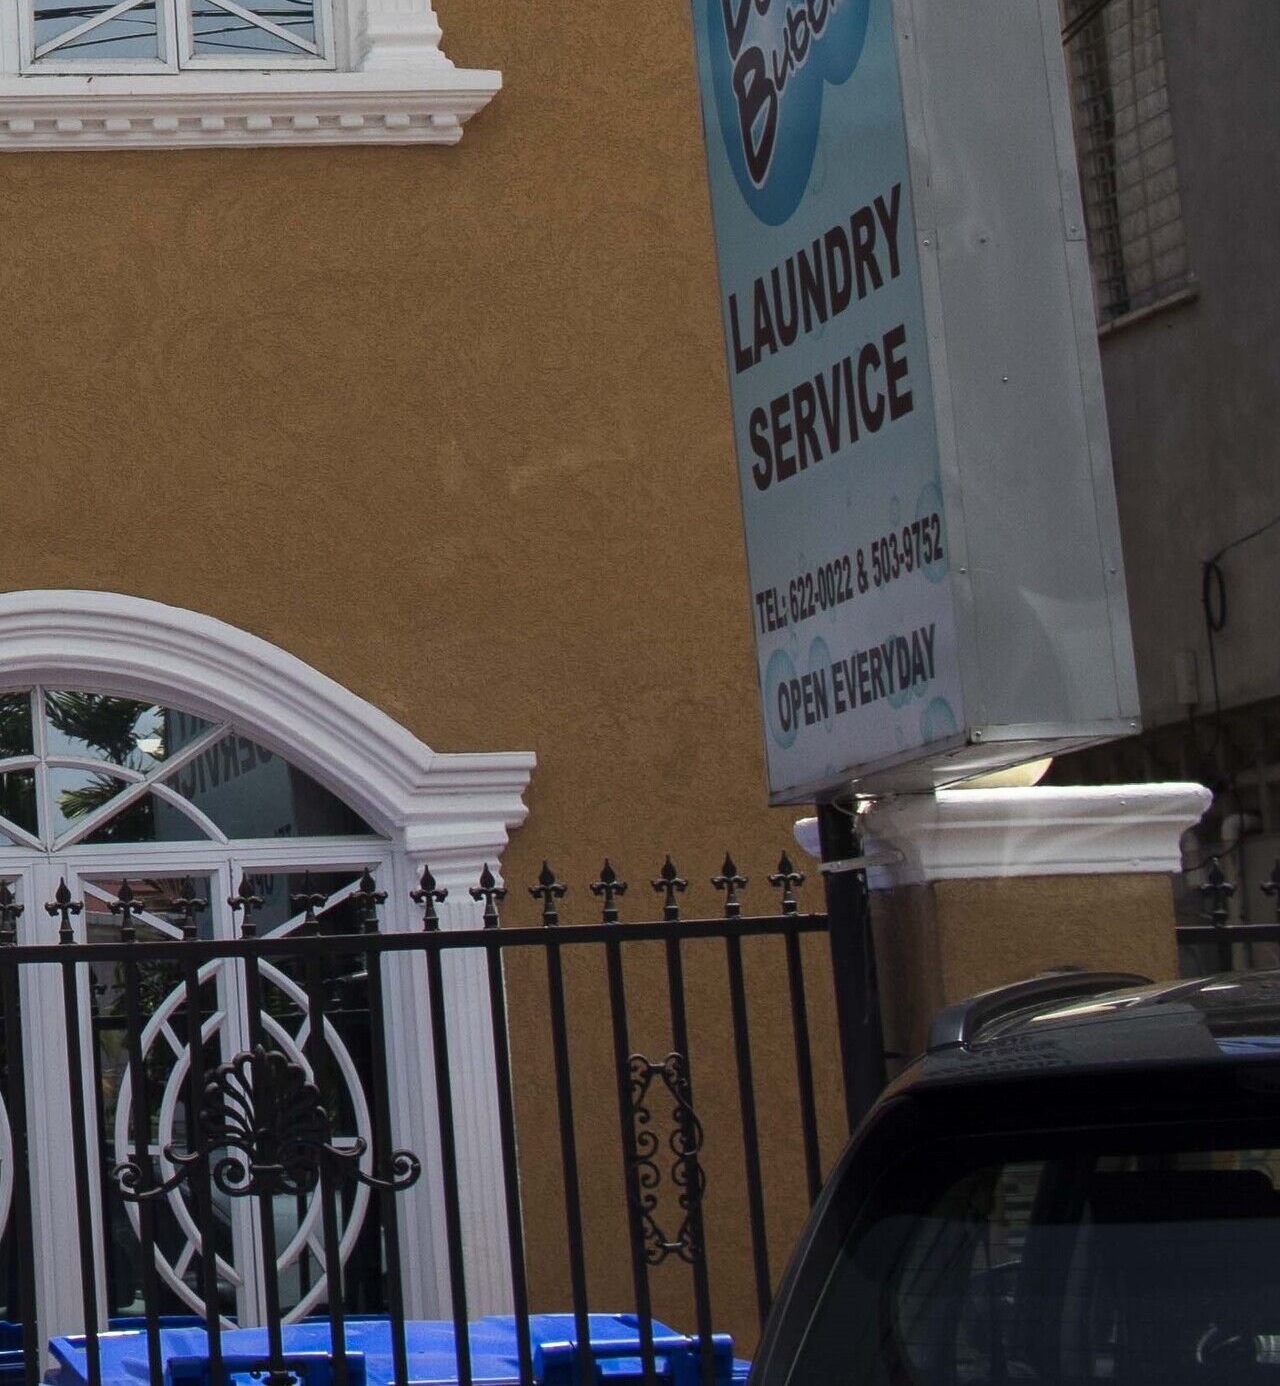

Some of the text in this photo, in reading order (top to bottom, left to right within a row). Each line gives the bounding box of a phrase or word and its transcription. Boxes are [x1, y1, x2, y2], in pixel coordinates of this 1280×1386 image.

[729, 183, 902, 374] LAUNDRY
[748, 324, 914, 492] SERVICE
[756, 512, 943, 634] TEL: 622-0022 & 503-9752
[777, 623, 936, 733] OPEN EVERYDAY
